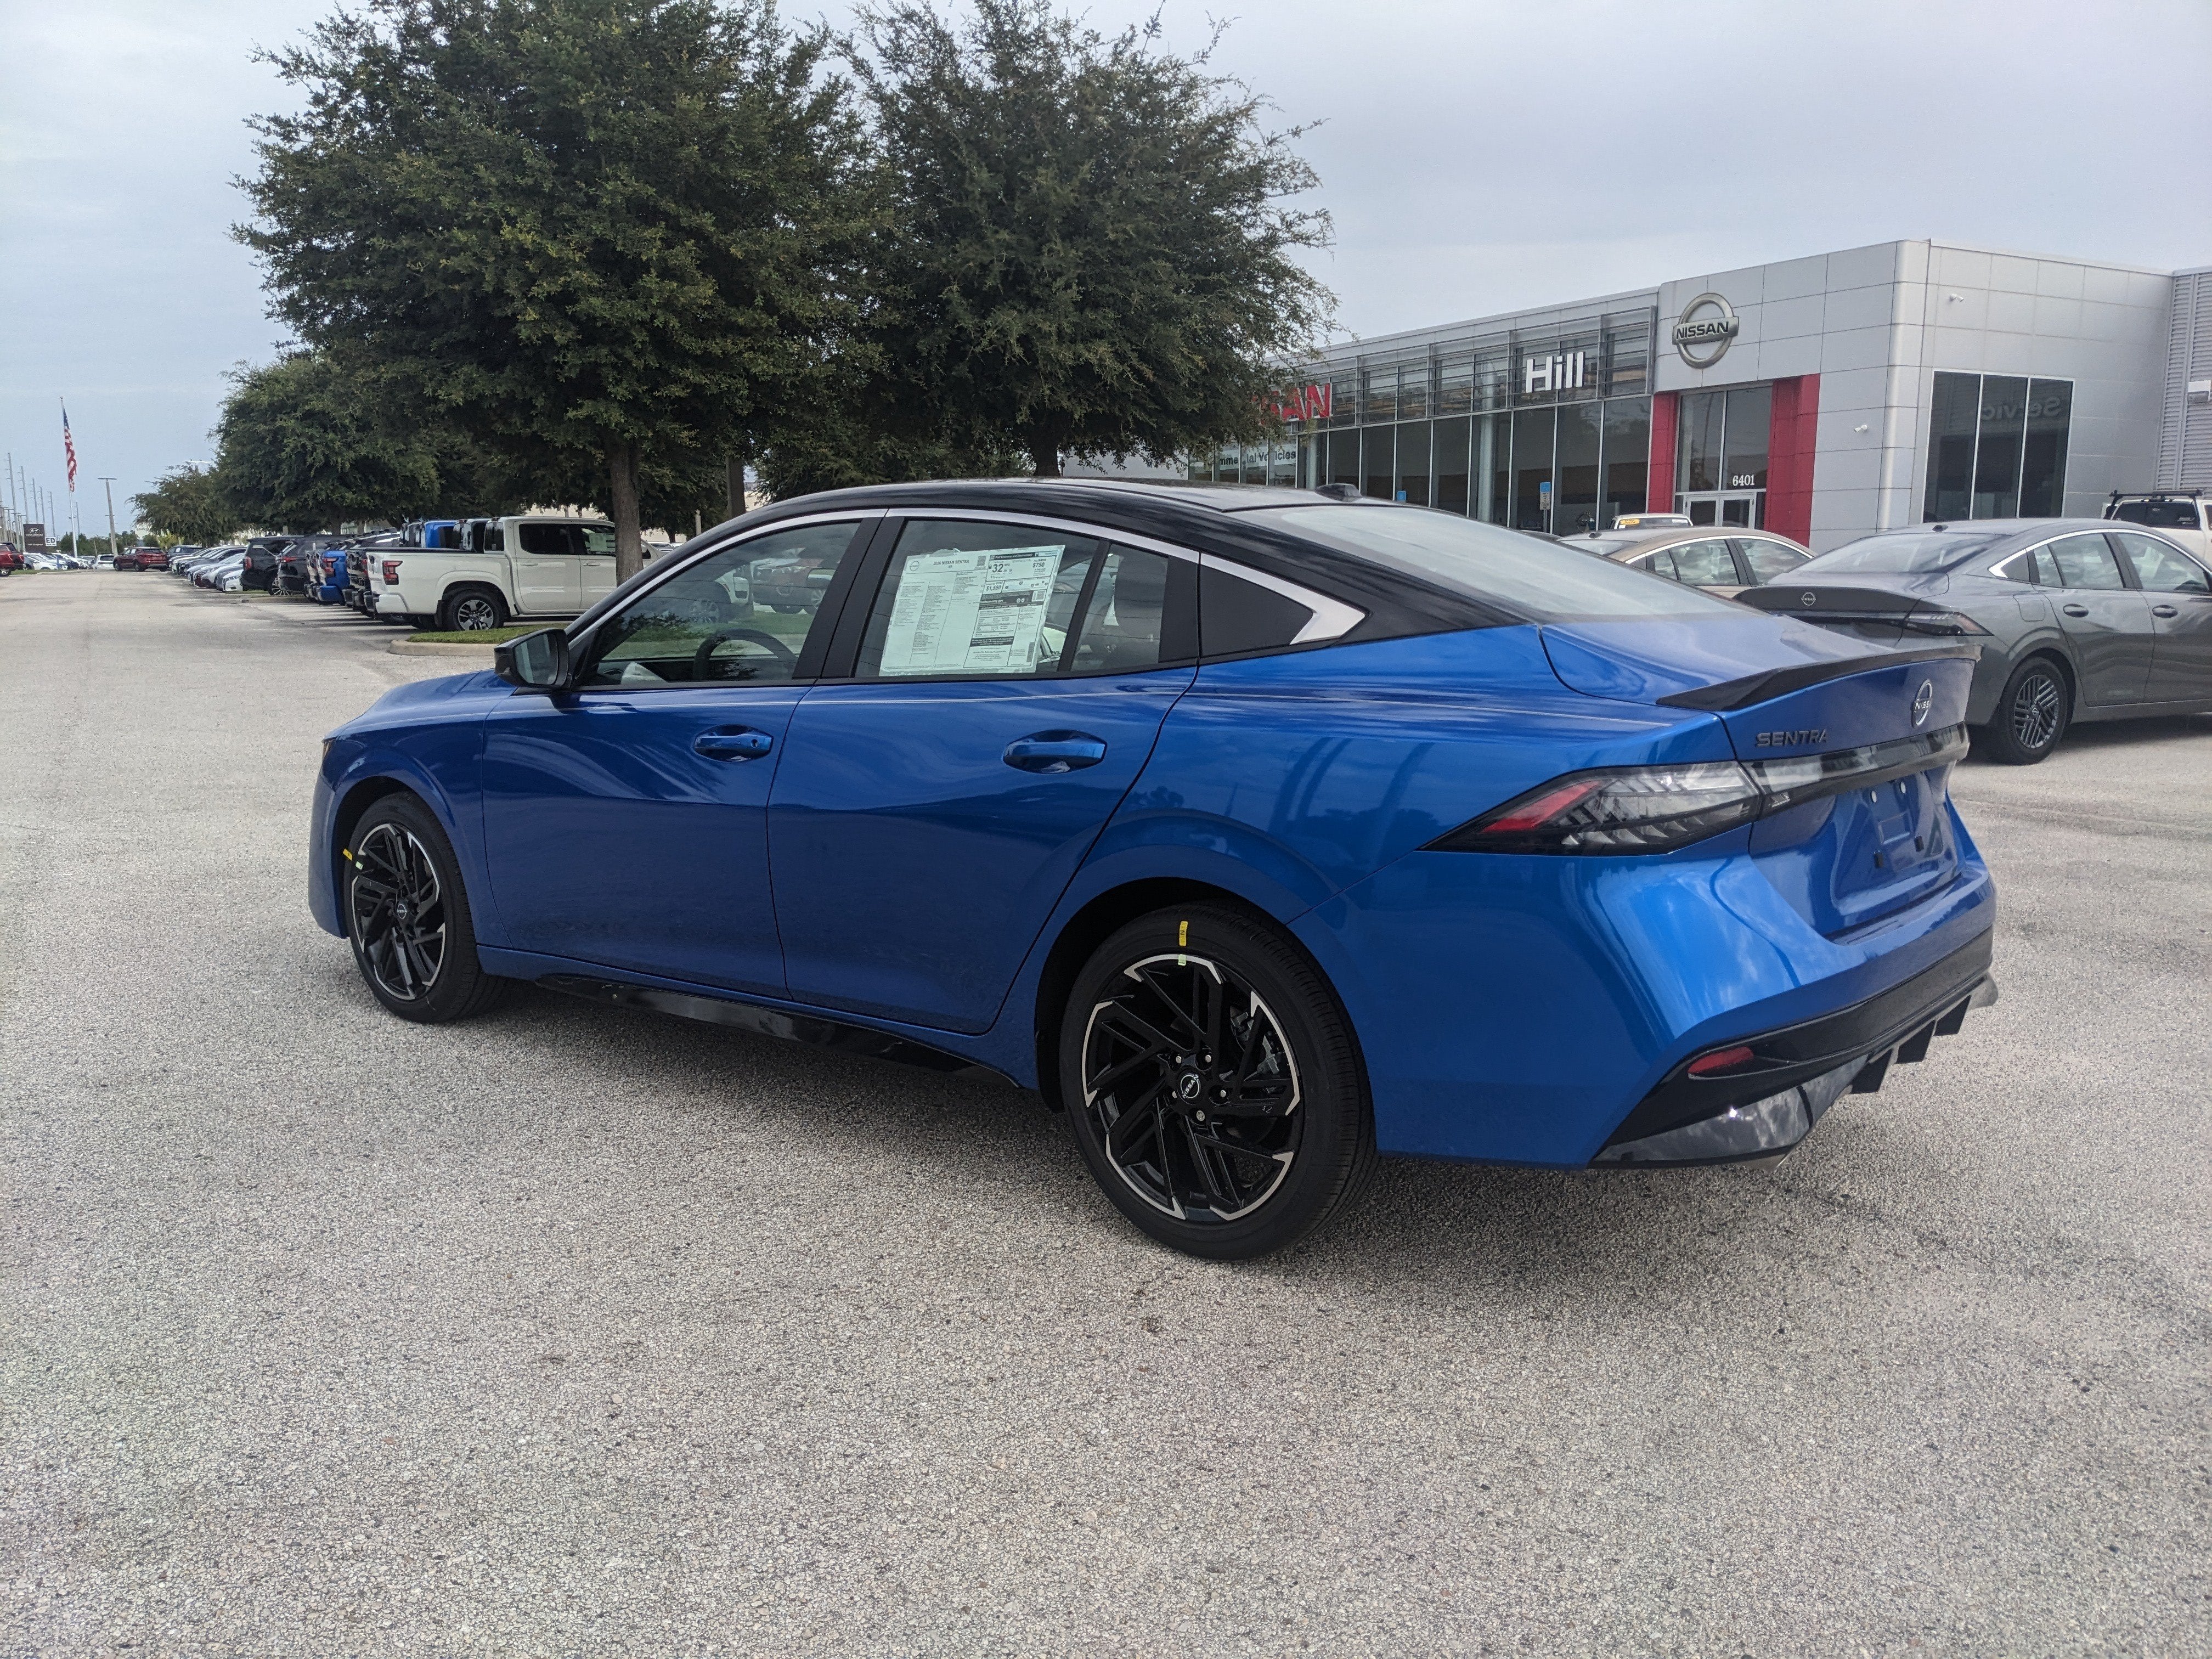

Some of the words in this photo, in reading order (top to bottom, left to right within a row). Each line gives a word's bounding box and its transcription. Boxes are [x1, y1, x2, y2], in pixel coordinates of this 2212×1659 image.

[1676, 321, 1729, 340] NISSAN
[1525, 351, 1585, 393] Hill
[1258, 450, 1296, 462] Veicles
[1732, 474, 1755, 487] 6401
[992, 563, 1003, 573] 32
[1915, 700, 1932, 710] NISS
[1756, 729, 1827, 747] SENTRA
[1182, 1073, 1199, 1099] NISSAN
